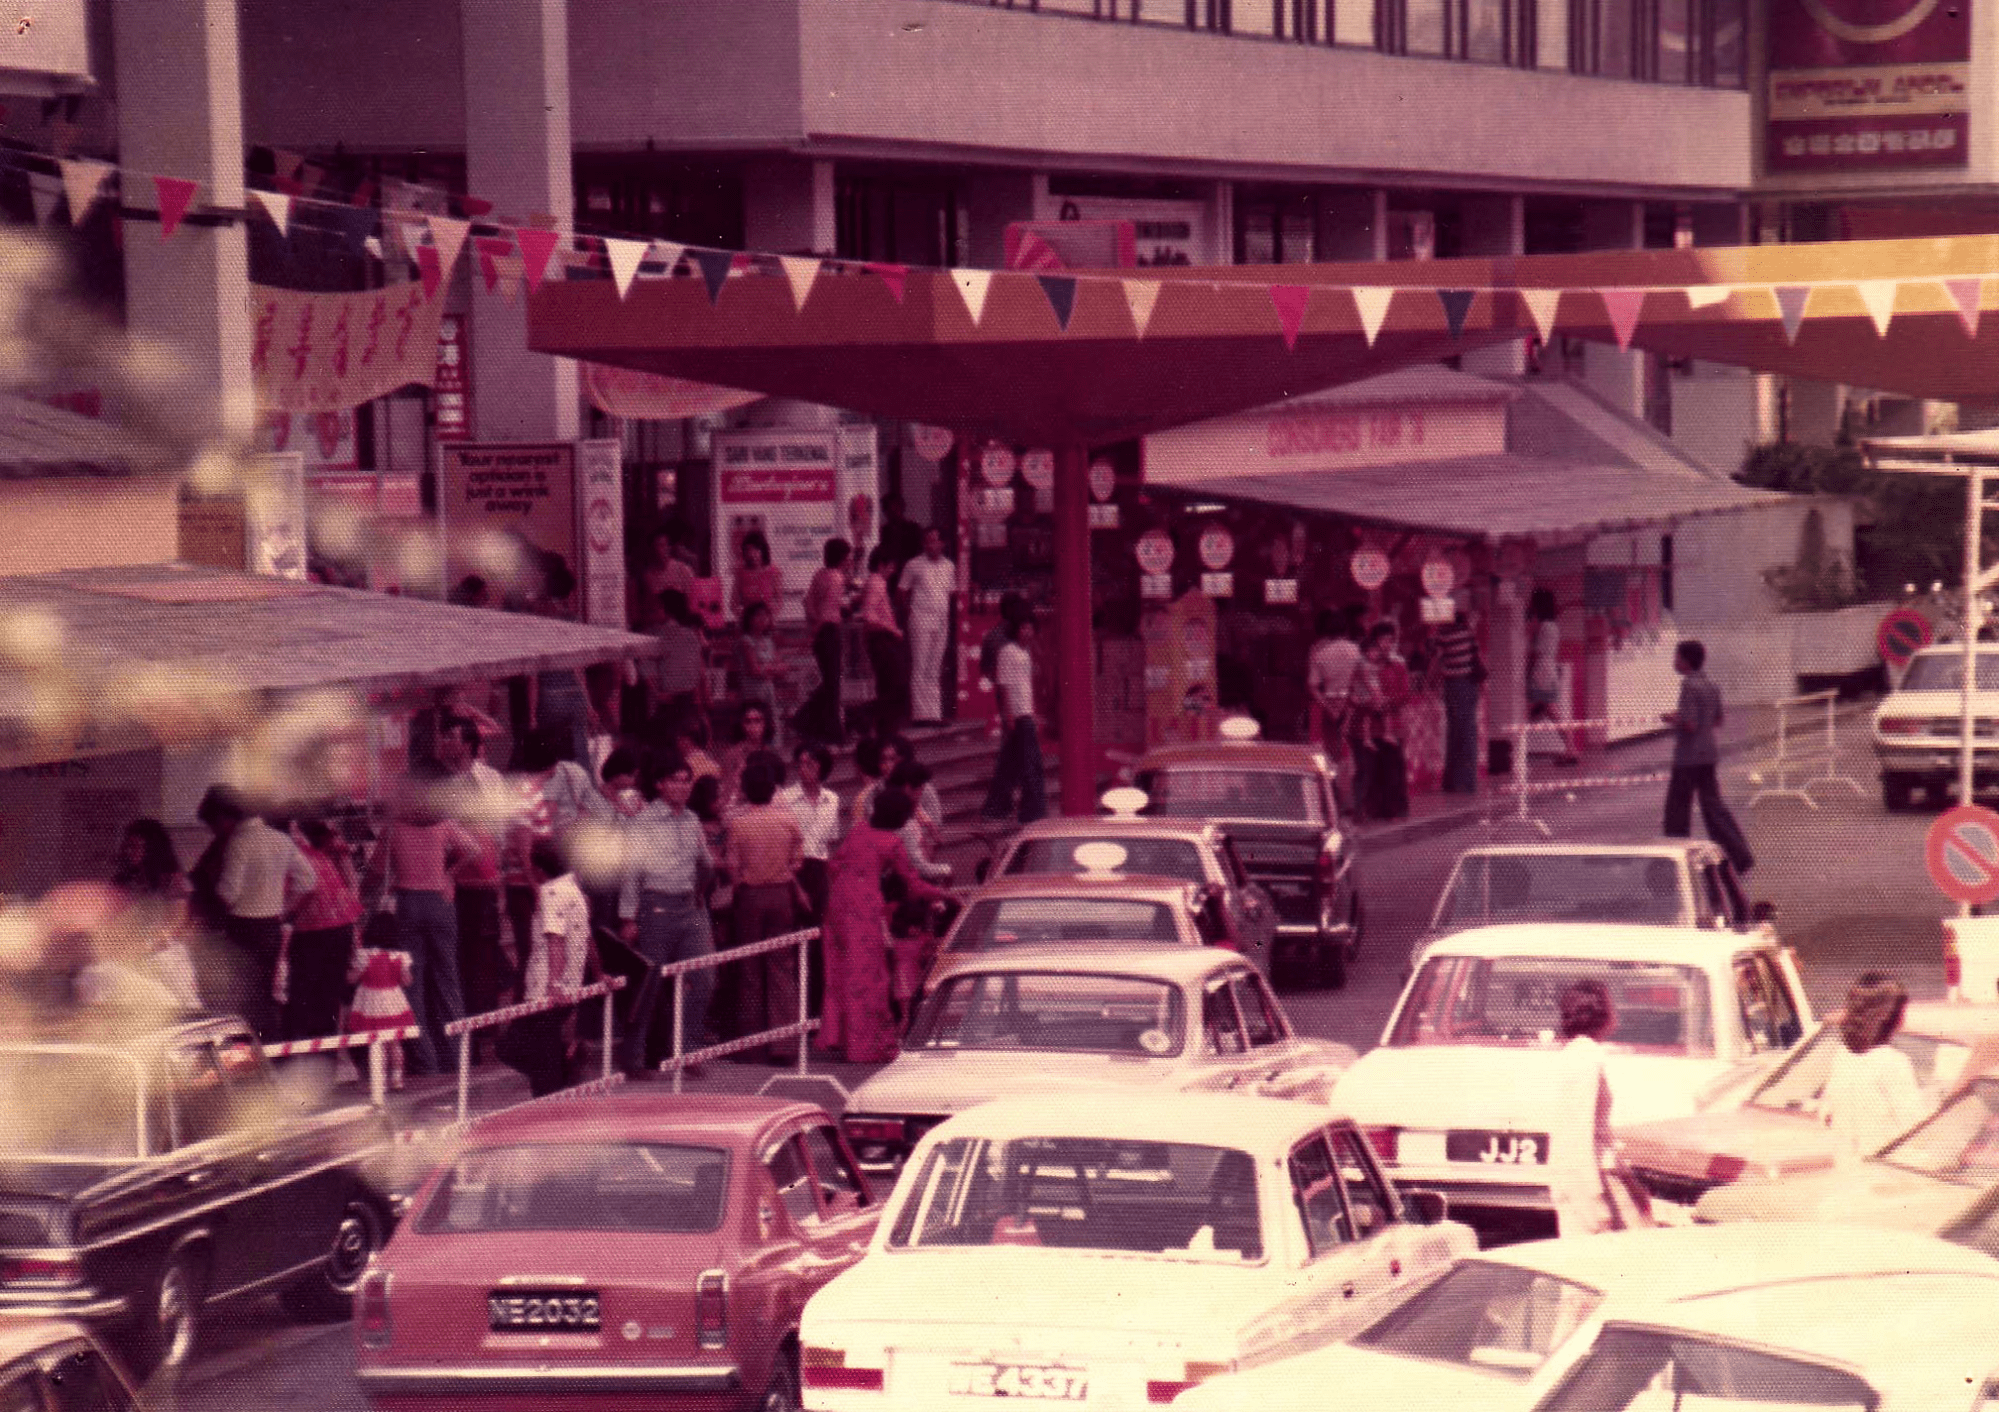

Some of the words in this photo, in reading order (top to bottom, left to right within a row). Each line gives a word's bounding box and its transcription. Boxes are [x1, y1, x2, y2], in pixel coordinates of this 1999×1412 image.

[459, 453, 493, 465] Your
[496, 453, 560, 465] nearest
[465, 486, 492, 503] just
[495, 488, 506, 498] a
[484, 501, 533, 515] away
[1479, 1136, 1538, 1164] JJ2
[489, 1298, 600, 1324] NE2032
